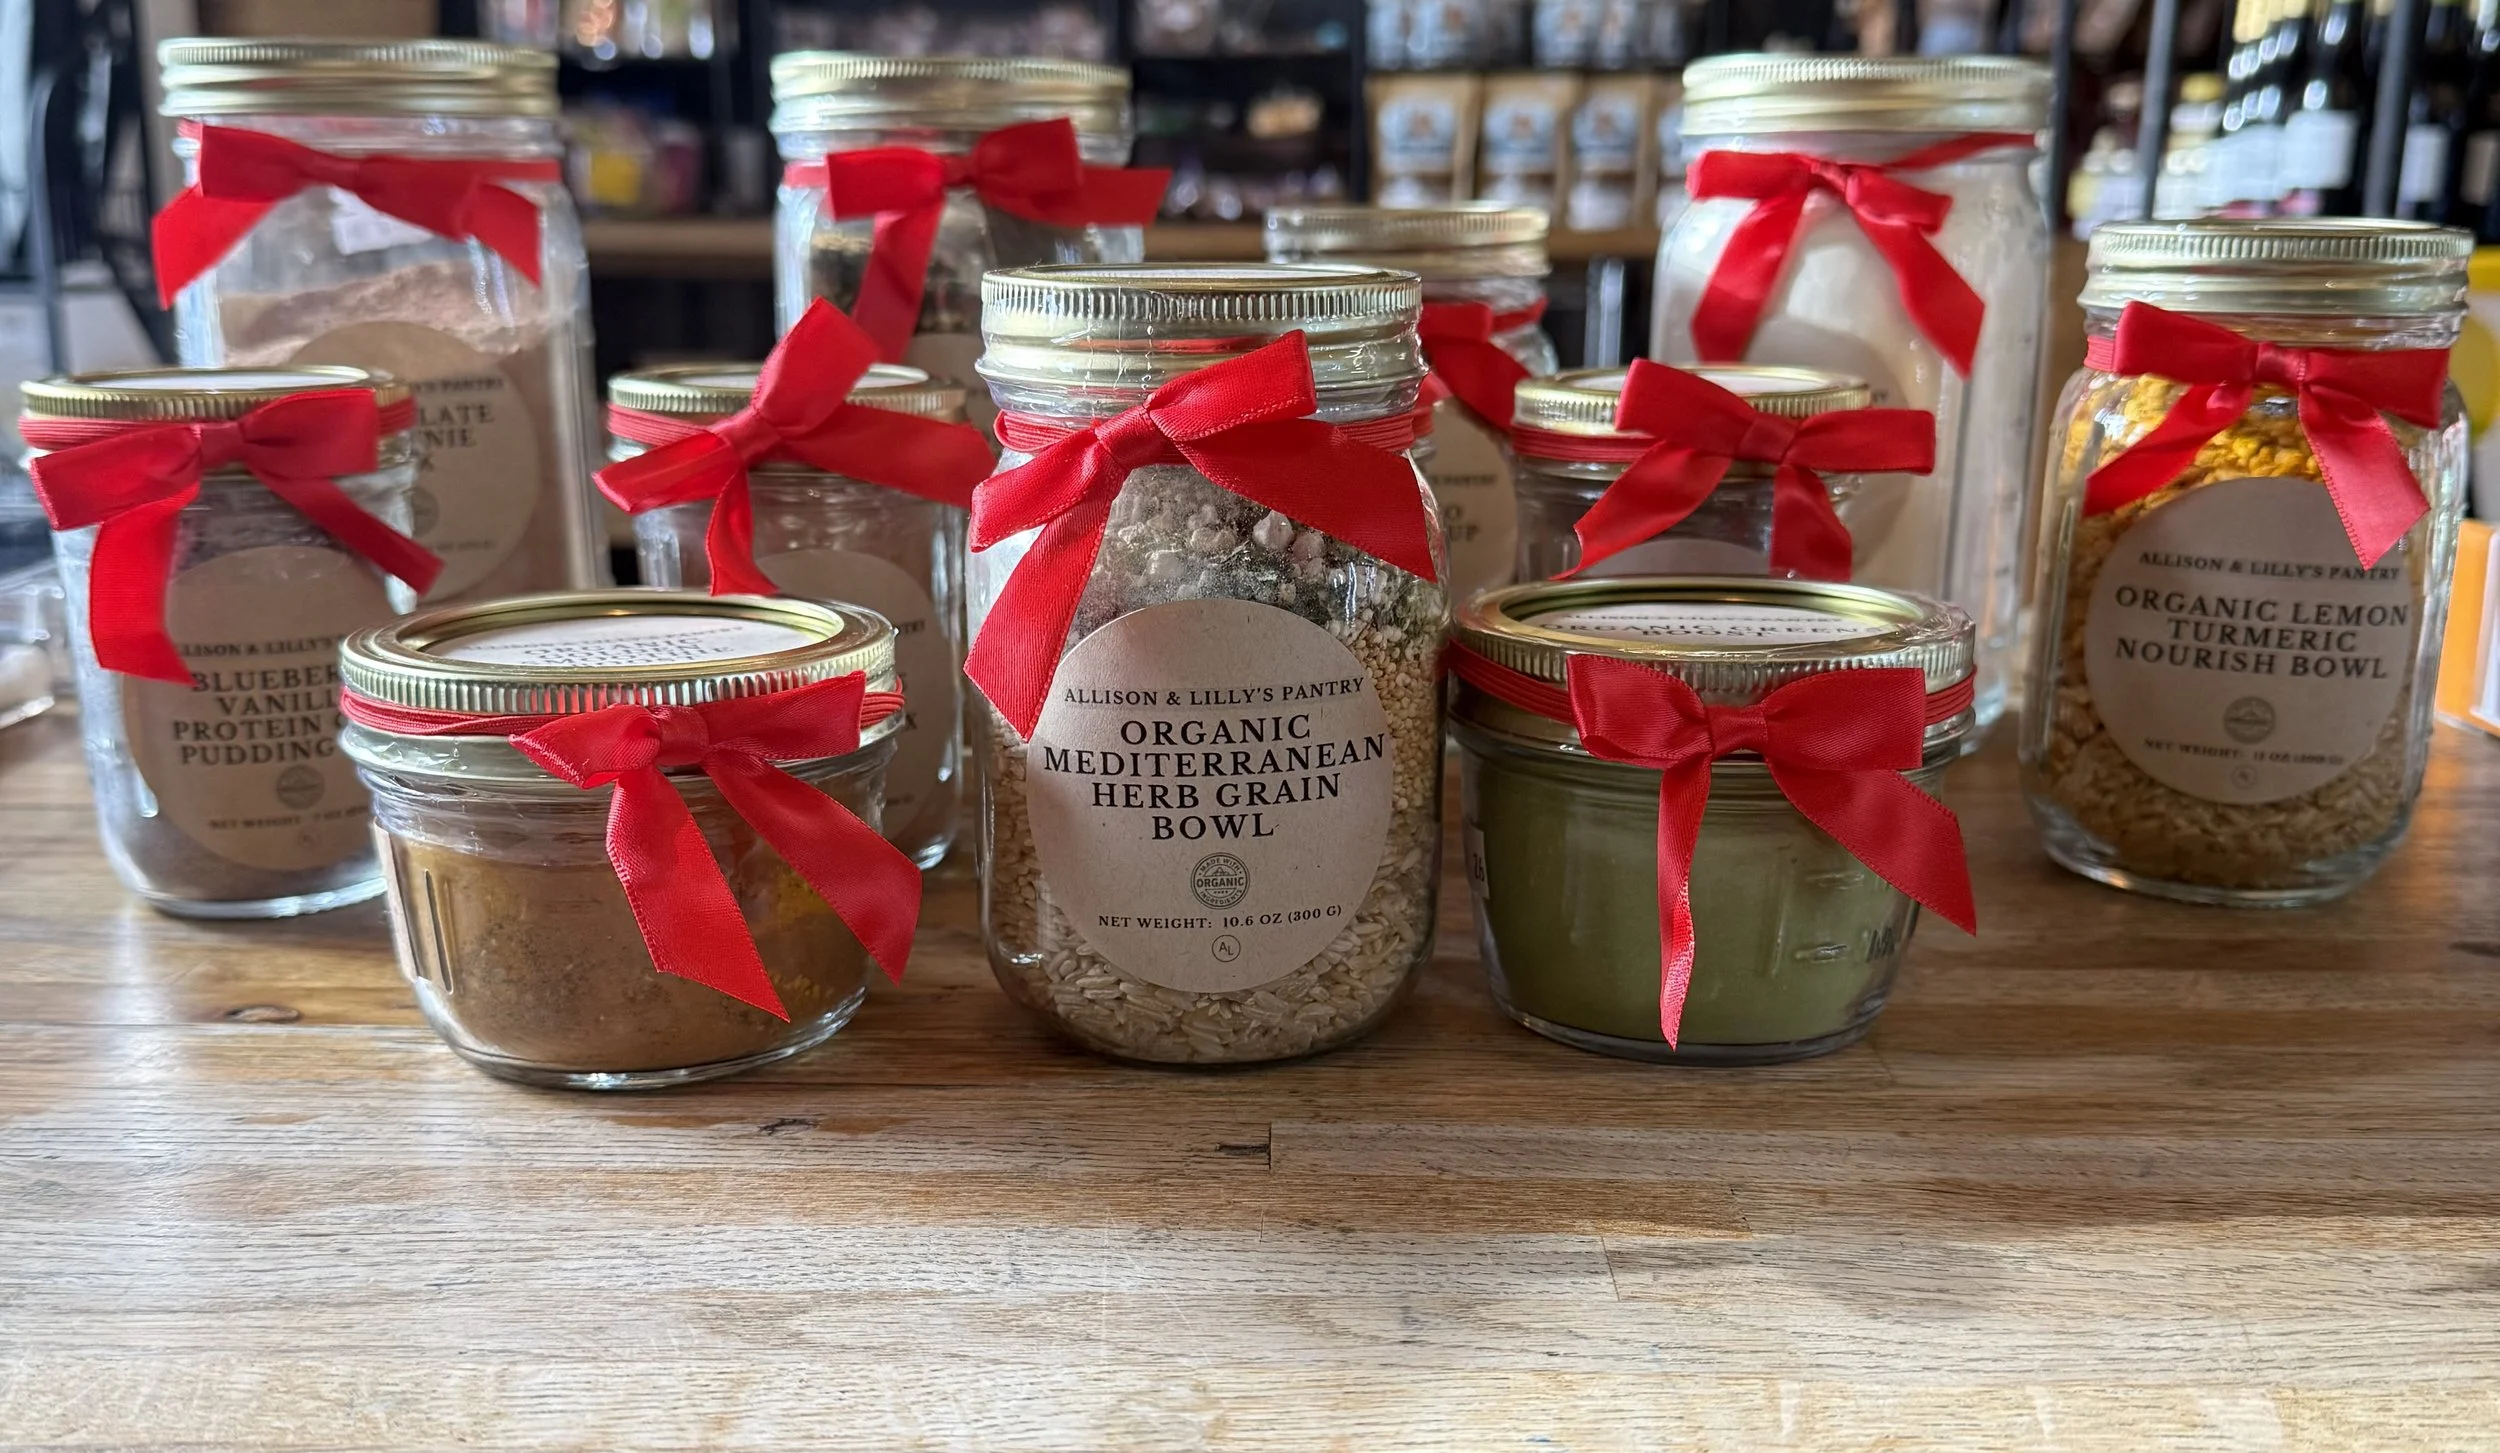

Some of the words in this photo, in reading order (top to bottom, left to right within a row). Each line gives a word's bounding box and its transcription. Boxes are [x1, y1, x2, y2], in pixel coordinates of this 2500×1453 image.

[2139, 551, 2224, 572] ALLISON
[2229, 560, 2243, 574] &
[2250, 561, 2323, 580] LILLY'S
[2329, 566, 2399, 582] PANTRY
[2116, 585, 2277, 622] ORGANIC
[2291, 601, 2408, 628] LEMON
[1540, 623, 1715, 631] ORGANIC
[1642, 629, 1769, 638] BOOST
[2166, 616, 2357, 653] TURMERIC
[524, 636, 703, 655] ORGANIC
[539, 643, 701, 660] GOLDEN
[2115, 636, 2276, 676] NOURISH
[2290, 653, 2388, 680] BOWL
[191, 665, 341, 693] BLUEBER
[1064, 688, 1158, 706] ALLISON
[1168, 691, 1181, 706] &
[1190, 687, 1274, 706] LILLY'S
[1282, 676, 1365, 701] PANTRY
[216, 689, 339, 715] VANILL
[172, 714, 321, 742] PROTEIN
[1120, 713, 1311, 746] ORGANIC
[181, 736, 334, 766] PUDDING
[1043, 732, 1386, 778] MEDITERRANEAN
[1092, 782, 1200, 809] HERB
[1215, 772, 1341, 809] GRAIN
[1151, 812, 1274, 841] BOWL
[1200, 857, 1220, 872] MADE
[1222, 858, 1241, 871] WITH
[1196, 876, 1244, 888] ORGANIC
[1098, 914, 1132, 929] NET
[1137, 915, 1212, 930] WEIGHT:
[1223, 914, 1254, 928] 10.6
[1259, 911, 1283, 926] OZ
[1288, 907, 1321, 925] (300
[1326, 903, 1343, 919] G)
[1218, 939, 1235, 957] AL
